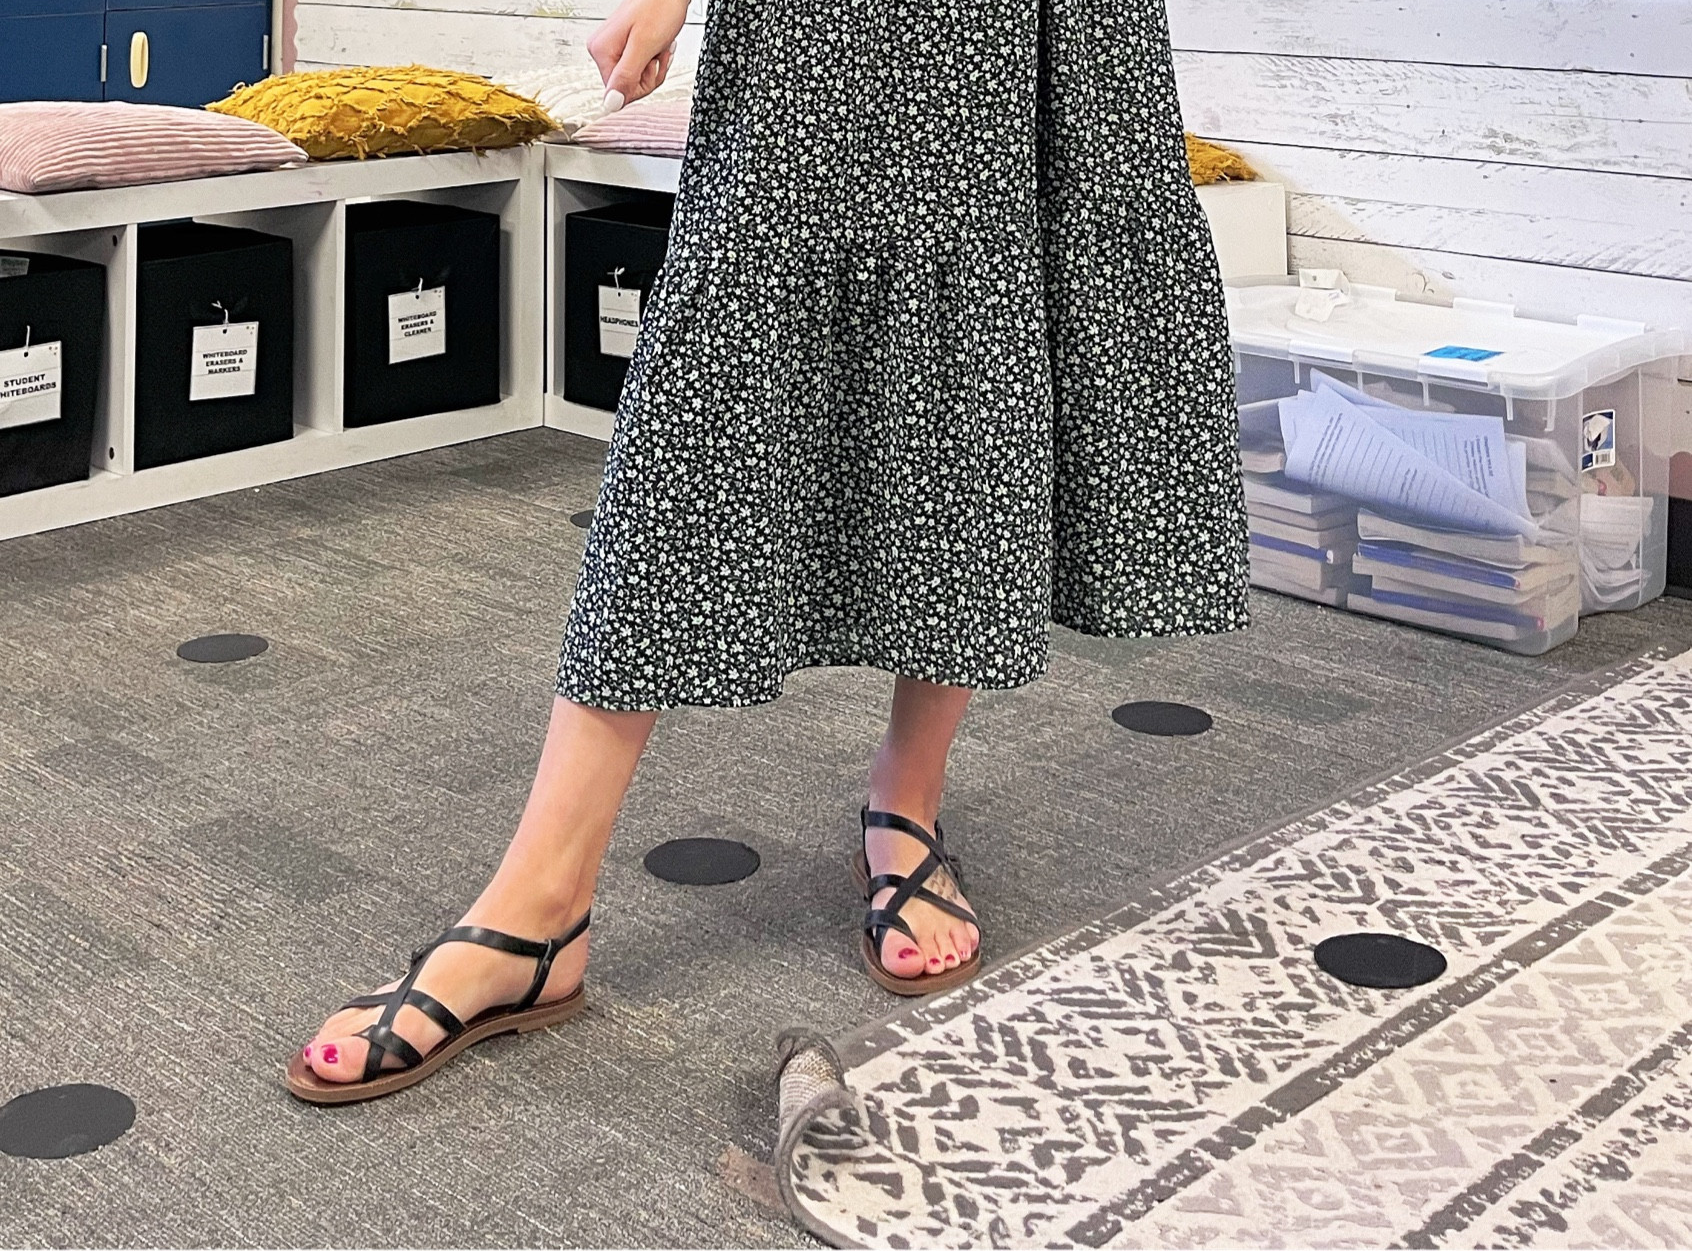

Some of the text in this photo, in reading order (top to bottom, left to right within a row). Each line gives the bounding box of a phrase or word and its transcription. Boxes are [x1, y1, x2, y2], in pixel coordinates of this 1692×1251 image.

[202, 349, 248, 359] WHITEBOARD
[205, 358, 237, 367] ERASERS
[207, 366, 241, 375] MARKERS
[3, 373, 46, 388] STUDENT
